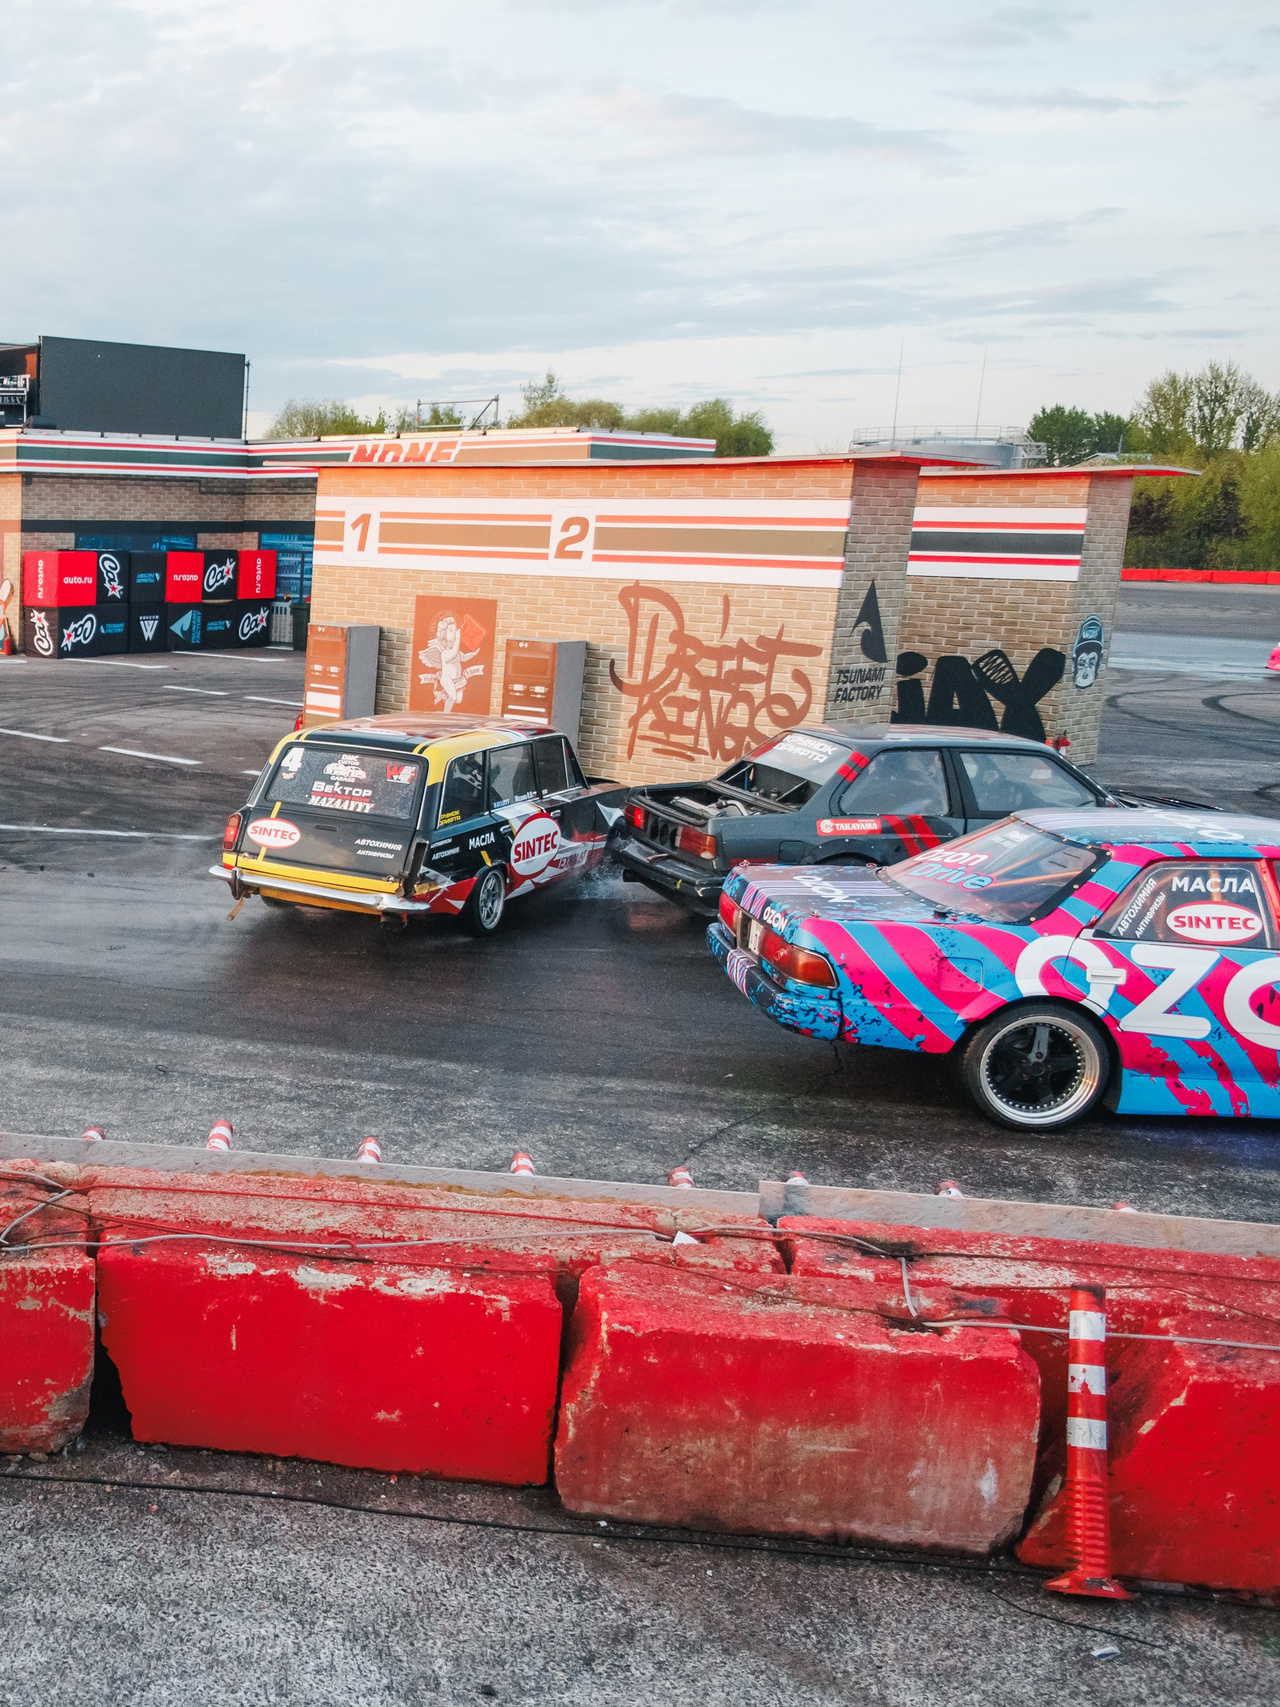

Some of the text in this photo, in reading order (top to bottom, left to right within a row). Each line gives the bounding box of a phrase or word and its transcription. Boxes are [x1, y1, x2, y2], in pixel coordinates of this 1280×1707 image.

[350, 513, 372, 552] 1
[554, 516, 590, 560] 2
[63, 576, 93, 585] auto.ru
[173, 574, 199, 582] auto.ru
[837, 667, 886, 685] TSUNAMI
[834, 685, 883, 703] FACTORY
[280, 747, 305, 772] 4
[342, 754, 360, 763] DMC
[330, 775, 356, 783] GARAGE
[250, 826, 297, 841] SINTEC
[834, 822, 878, 831] TAKAYAMA
[354, 838, 403, 851] АВТОХИМИЯ
[469, 832, 496, 850] МАСЛА
[513, 830, 558, 863] SINTEC
[432, 847, 460, 860] АВТОХИМИЯ
[907, 863, 994, 889] Drive
[1171, 876, 1255, 893] МАСЛА
[792, 875, 857, 903] OZON
[1117, 878, 1158, 937] АВТОХИМИЯ
[1134, 891, 1167, 939] АНТИФРИЗЫ
[763, 905, 789, 932] OZON
[1173, 915, 1256, 931] SINTEC
